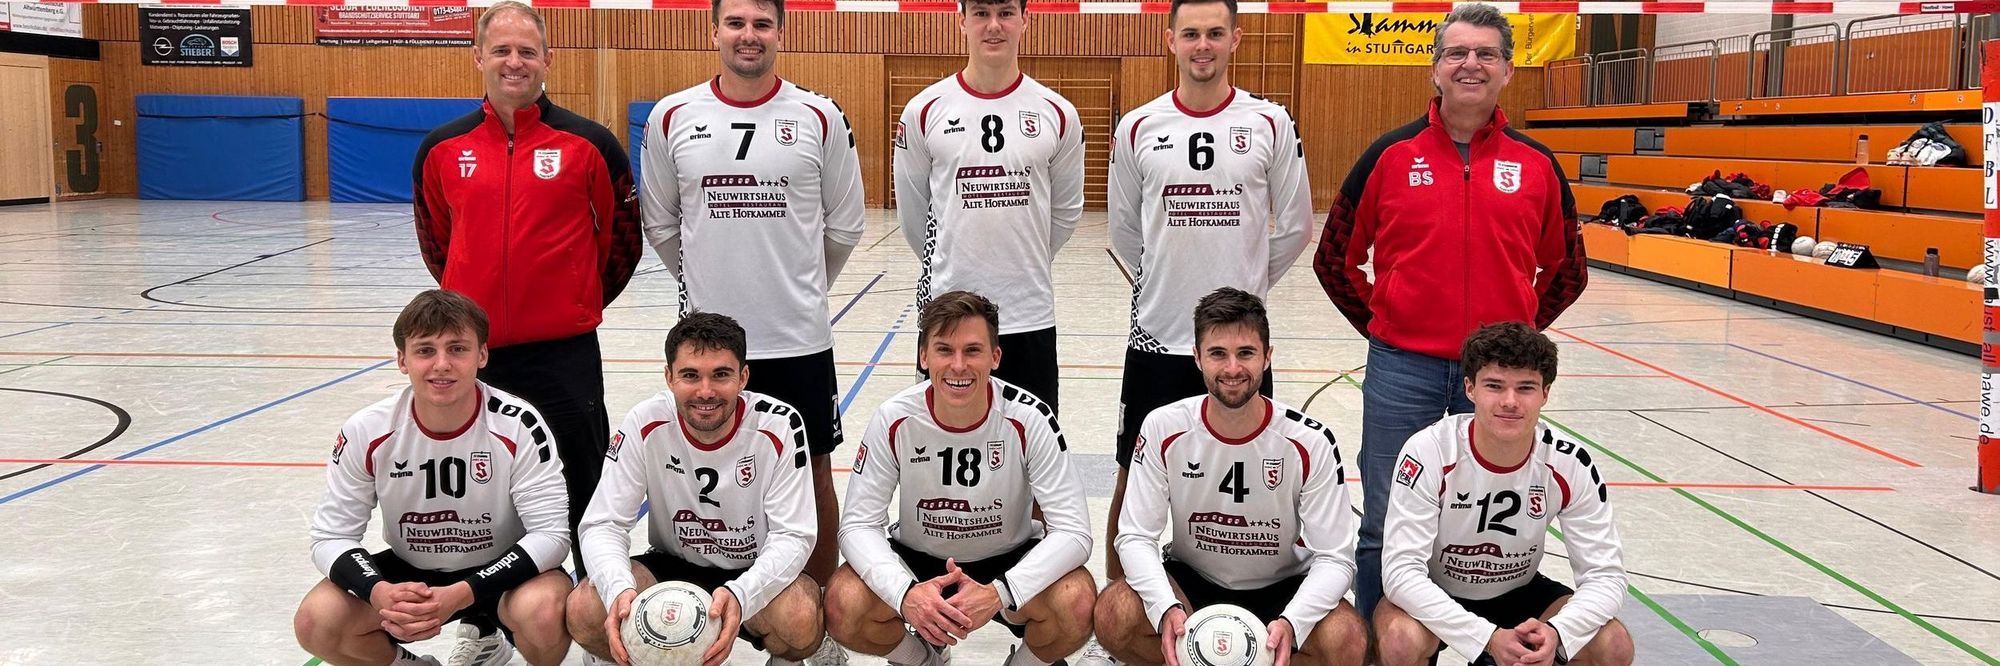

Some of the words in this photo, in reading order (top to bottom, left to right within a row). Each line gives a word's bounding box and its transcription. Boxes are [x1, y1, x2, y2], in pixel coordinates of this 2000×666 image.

[180, 48, 212, 56] STIEBER
[1346, 42, 1361, 53] in
[1366, 41, 1434, 54] STUTTGAR
[944, 126, 966, 134] erima
[981, 114, 1004, 154] 8
[65, 84, 100, 193] 3
[731, 122, 756, 160] 7
[1153, 143, 1174, 151] erima
[1188, 132, 1214, 171] 6
[458, 164, 478, 178] 17
[1408, 170, 1434, 186] BS
[962, 200, 983, 209] ALTE
[710, 210, 730, 218] ALTE
[1167, 218, 1187, 226] ALTE
[910, 456, 930, 464] erima
[937, 446, 982, 487] 18
[390, 470, 413, 478] erima
[420, 456, 466, 500] 10
[1182, 471, 1204, 479] erima
[694, 466, 720, 508] 2
[1218, 462, 1250, 503] 4
[1450, 502, 1472, 510] erima
[1476, 490, 1522, 536] 12
[679, 526, 756, 546] NEUWTSHAUS
[923, 528, 944, 538] ALTE
[409, 544, 432, 553] ALTE
[1196, 540, 1218, 552] ALTE
[350, 552, 378, 577] Kempa
[476, 552, 520, 578] Kempa
[1444, 570, 1468, 582] ALTE
